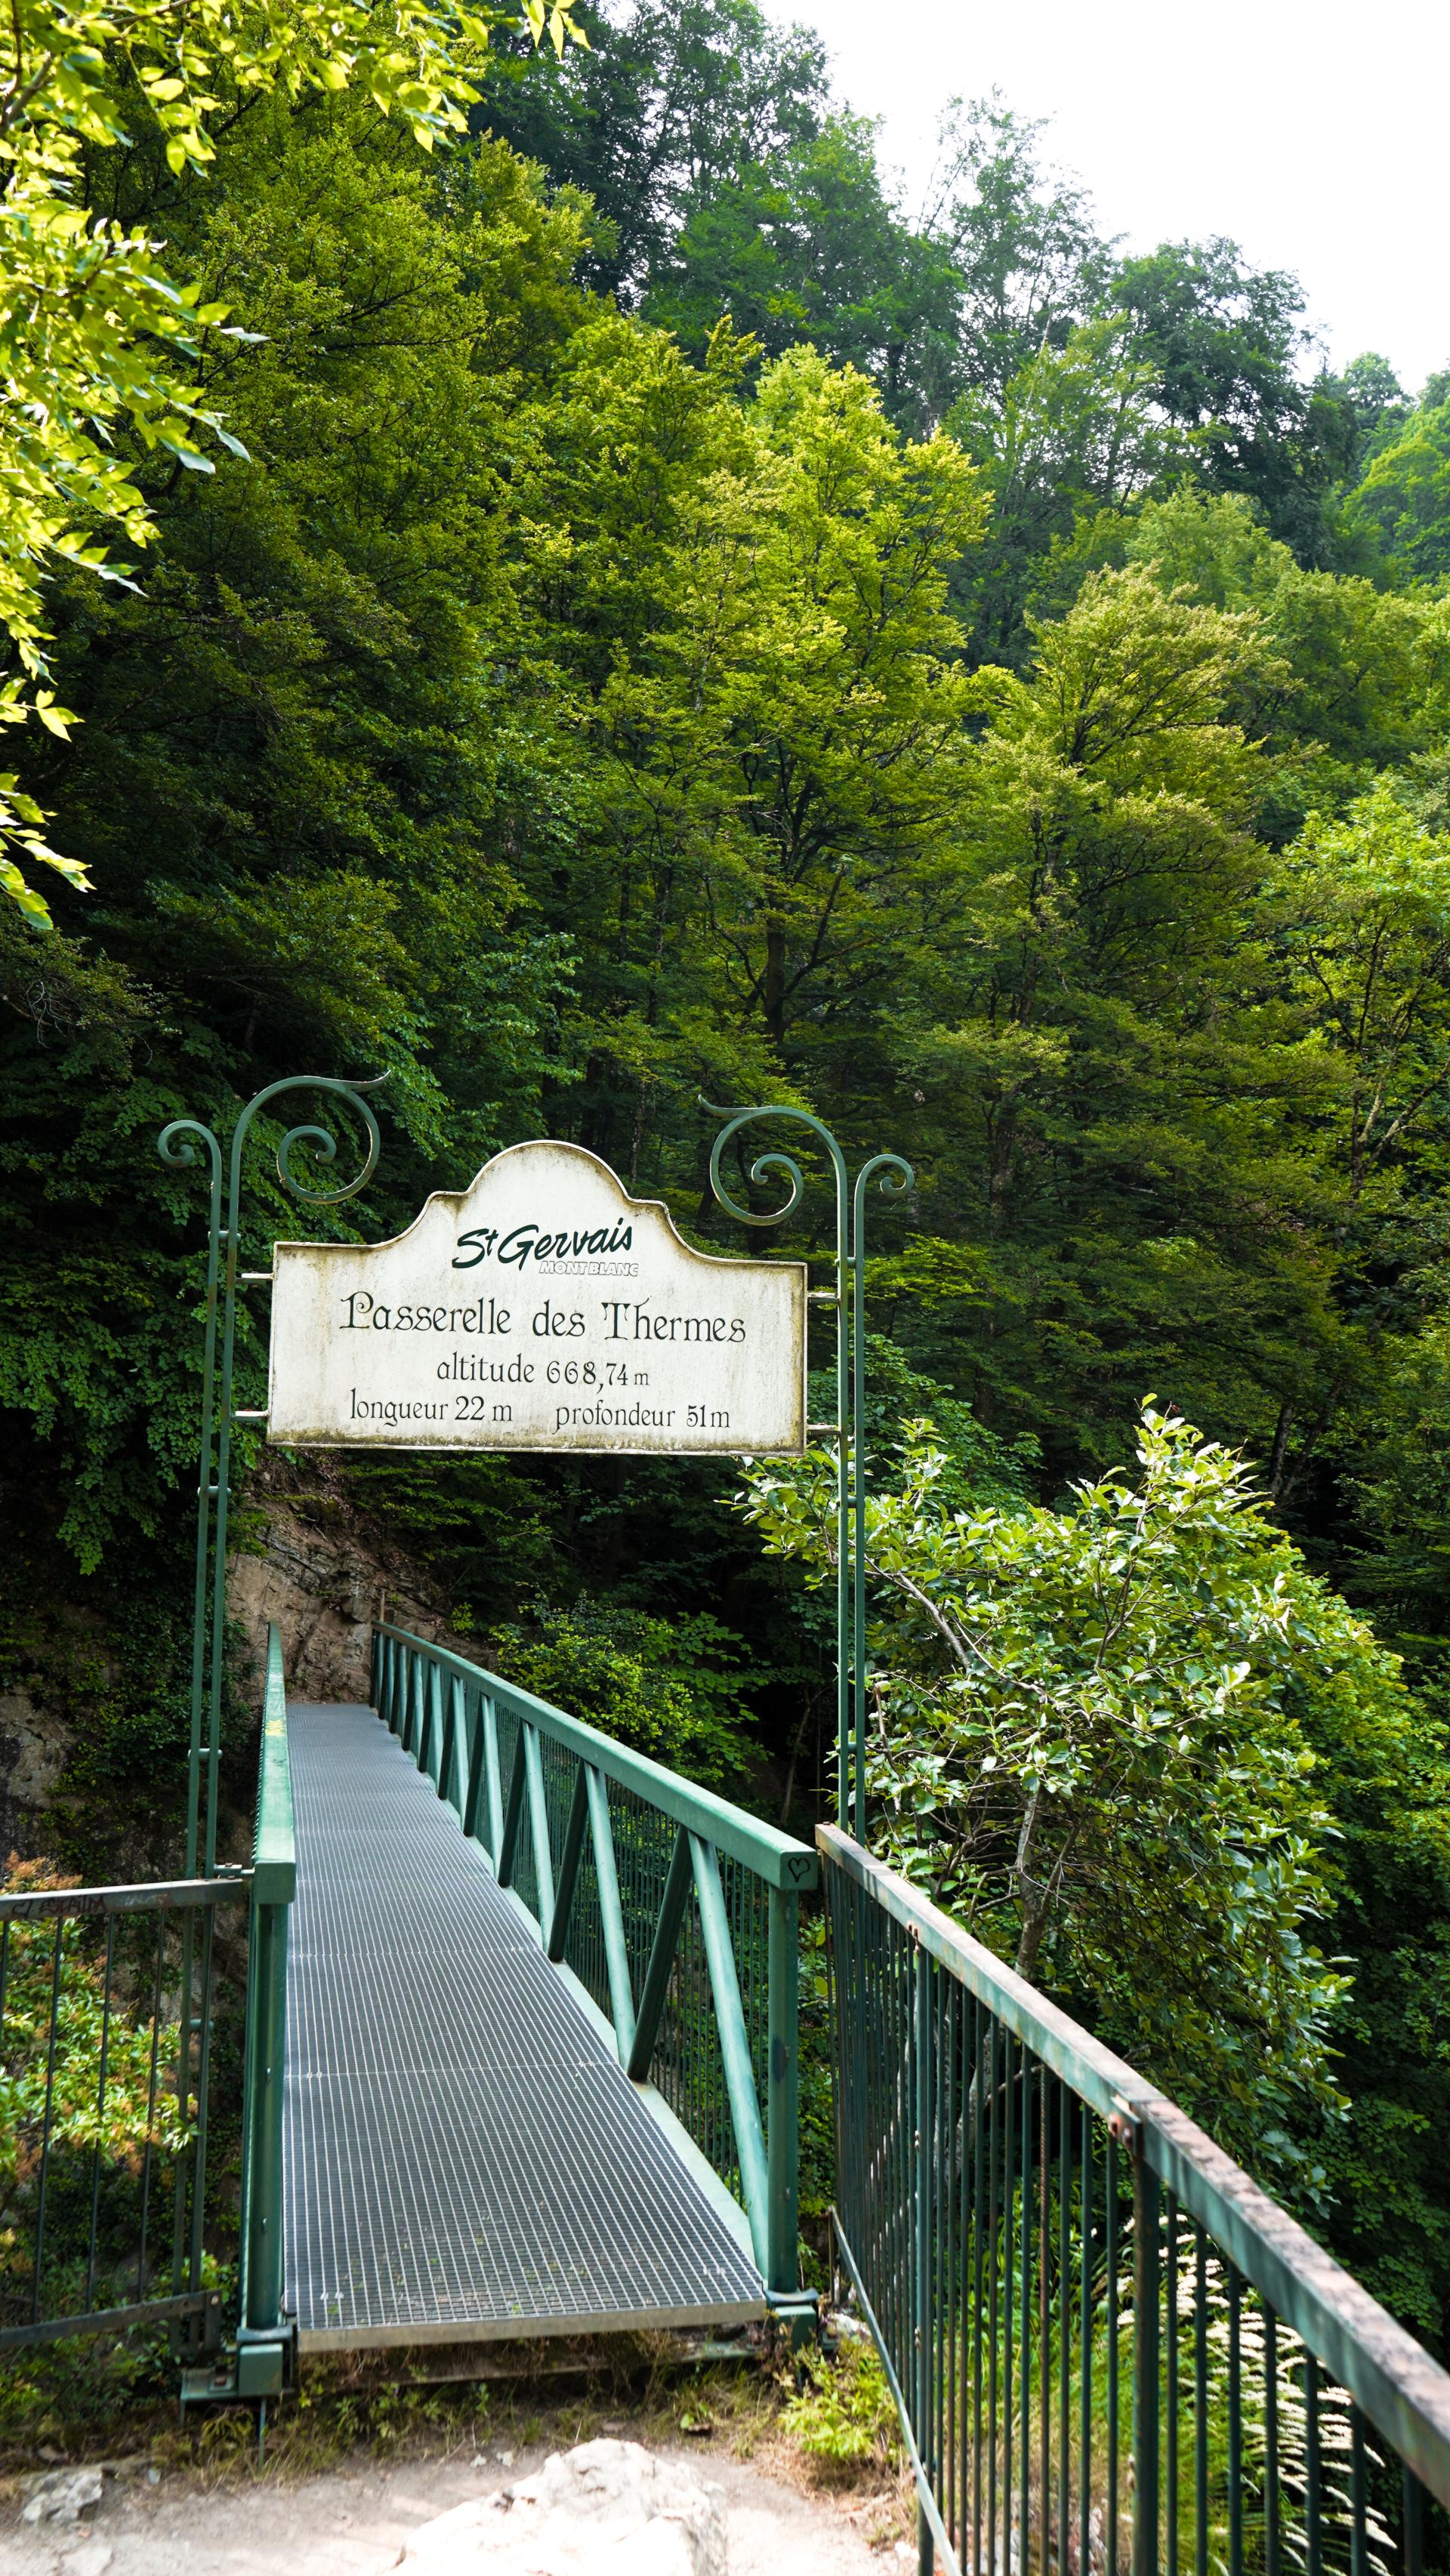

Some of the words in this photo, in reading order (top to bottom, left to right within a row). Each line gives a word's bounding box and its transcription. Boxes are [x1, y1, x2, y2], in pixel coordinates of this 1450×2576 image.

[452, 1228, 499, 1269] St
[497, 1217, 632, 1271] Gervais
[539, 1260, 588, 1275] MONT
[588, 1261, 639, 1277] BLANC
[339, 1291, 511, 1335] Passerelle
[532, 1299, 585, 1337] des
[601, 1297, 746, 1343] Thermes
[437, 1351, 535, 1383] altitude
[546, 1360, 628, 1394] 668,74
[350, 1387, 449, 1427] longueur
[454, 1395, 486, 1421] 22
[492, 1404, 513, 1422] m
[552, 1399, 676, 1435] profondeur
